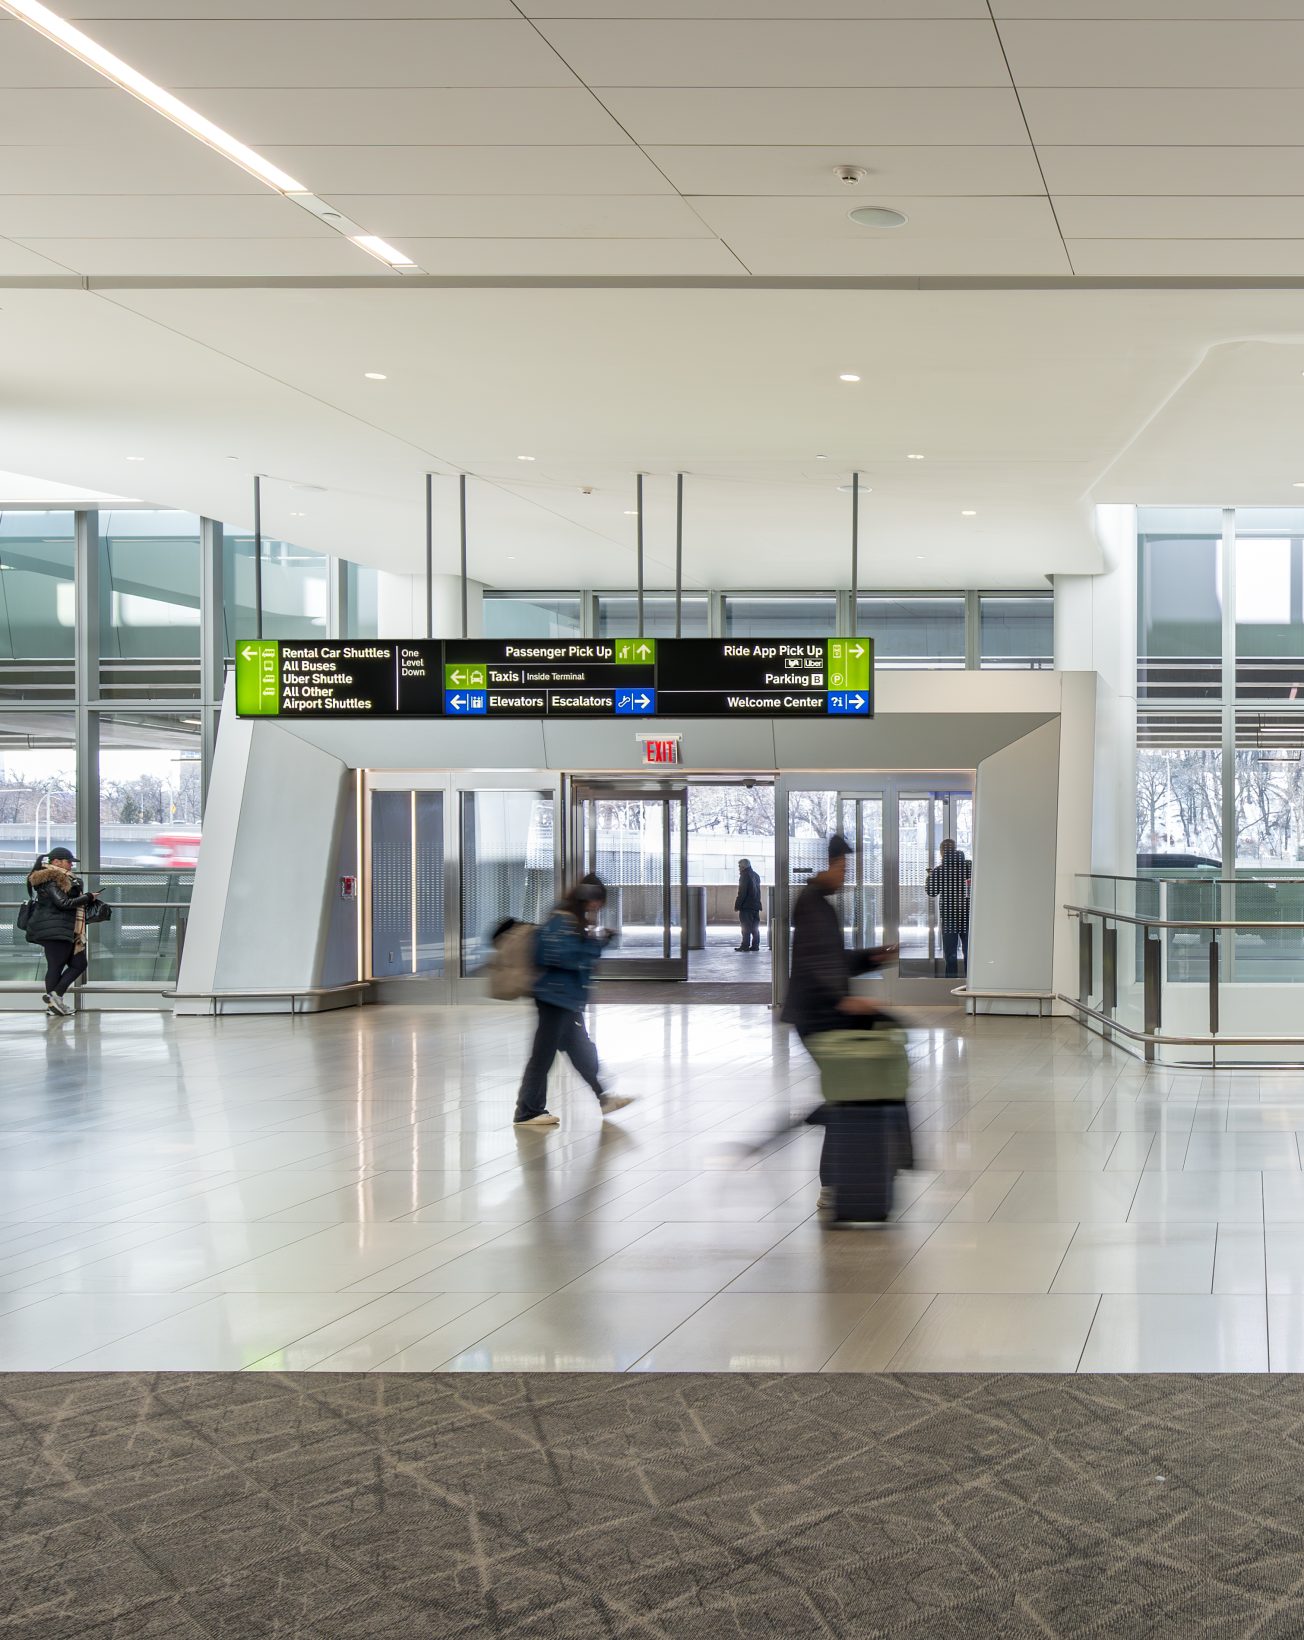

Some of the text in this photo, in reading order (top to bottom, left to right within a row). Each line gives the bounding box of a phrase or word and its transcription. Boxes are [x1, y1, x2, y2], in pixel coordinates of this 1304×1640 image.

[282, 647, 390, 658] Rental Car Shuttles
[401, 649, 419, 657] One
[505, 646, 612, 659] Passenger Pick Up
[724, 645, 823, 658] Ride App Pick Up
[282, 660, 337, 671] All Buses
[401, 658, 424, 667] Level
[401, 668, 425, 676] Down
[489, 671, 585, 682] Taxis Inside Terminal
[282, 673, 352, 684] Uber Shuttle
[765, 674, 820, 686] Parking B
[282, 686, 334, 697] All Other
[282, 698, 372, 711] Airport Shuttles
[489, 696, 544, 707] Elevators
[552, 696, 613, 707] Escalators
[727, 696, 823, 707] Welcome Center
[647, 741, 673, 762] EXIT
